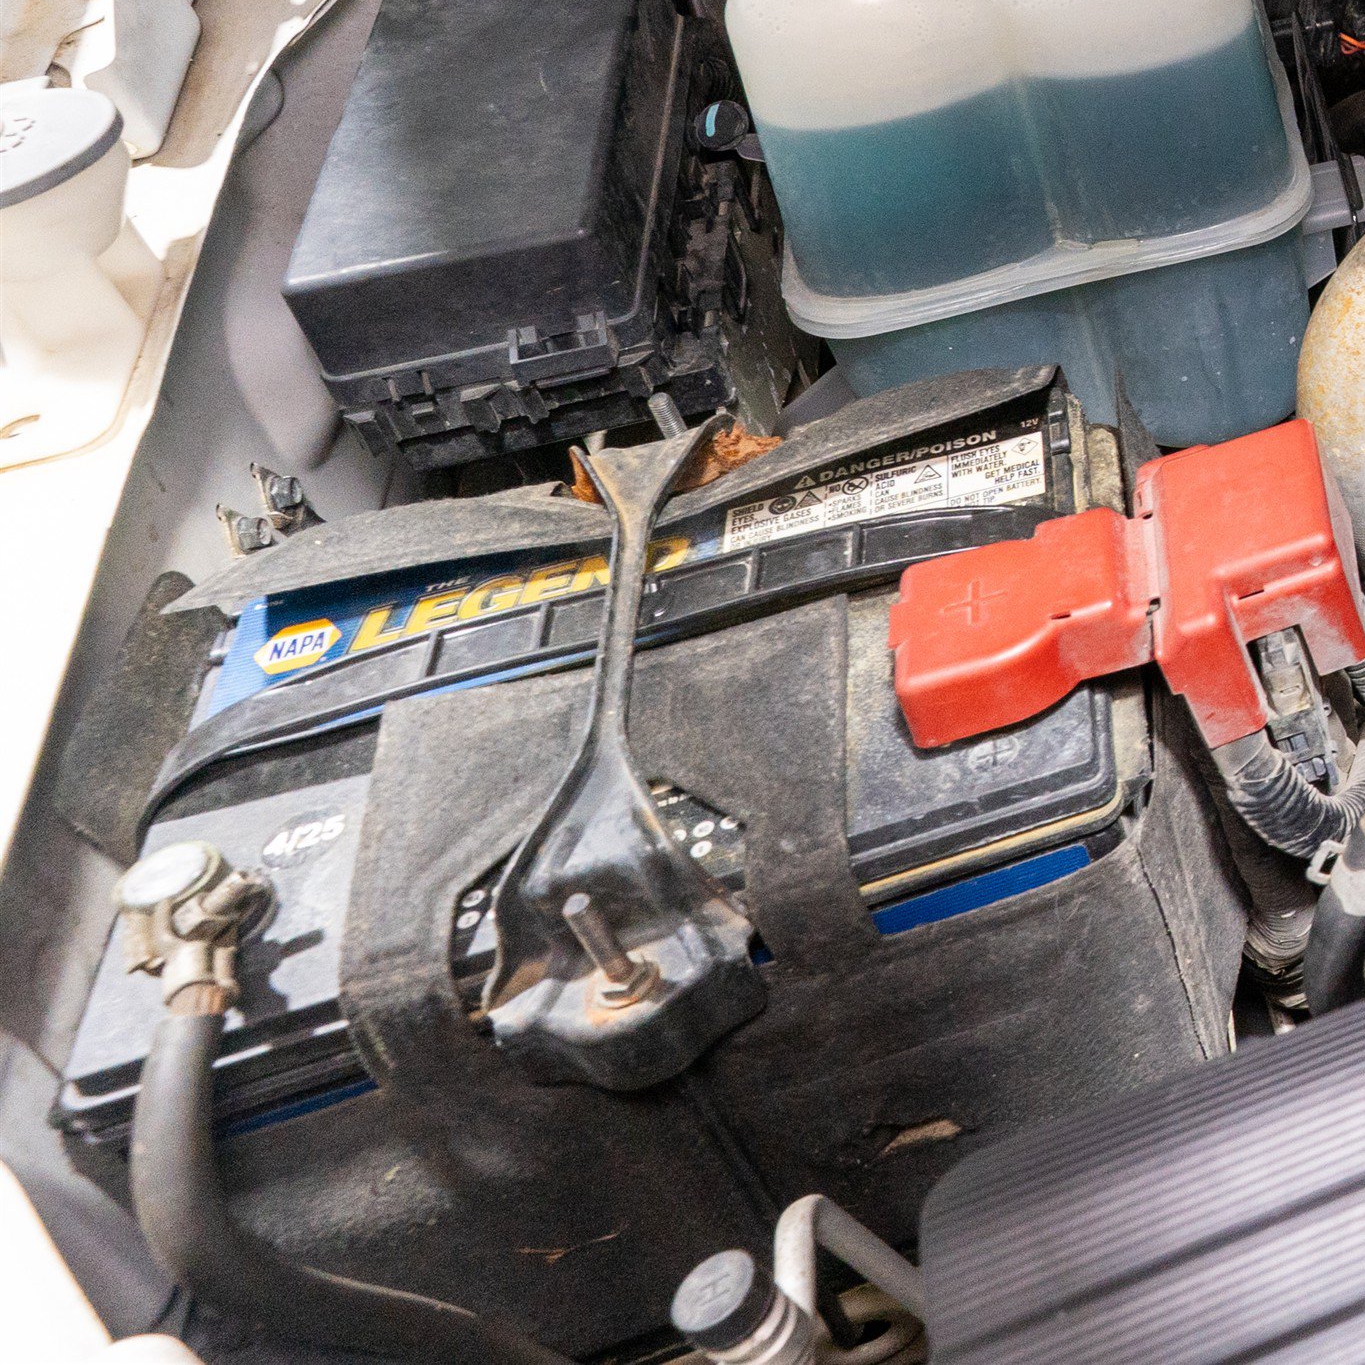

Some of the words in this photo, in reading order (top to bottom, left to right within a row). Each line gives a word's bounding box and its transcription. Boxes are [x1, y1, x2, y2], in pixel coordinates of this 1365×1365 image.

[1020, 418, 1039, 429] 12V
[819, 430, 997, 482] DANGER/POISON
[951, 452, 977, 463] FLUSH
[979, 445, 1000, 455] EYES
[951, 451, 1008, 471] IMMEDIATELY
[875, 465, 917, 482] SULFURIC
[951, 467, 973, 479] WITH
[985, 470, 1000, 480] GET
[1003, 459, 1040, 474] MEDICAL
[875, 480, 896, 491] ACID
[994, 474, 1015, 485] HELP
[828, 484, 841, 494] NO
[875, 489, 890, 498] CAN
[950, 497, 962, 507] DO
[964, 492, 980, 503] NOT
[982, 487, 1004, 498] OPEN
[874, 494, 899, 506] CAUSE
[887, 497, 916, 510] SEVERE
[917, 491, 944, 503] BURNS
[733, 503, 764, 517] SHIELD
[731, 516, 780, 535] EXPLOSIVE
[783, 508, 812, 522] GASES
[748, 526, 775, 540] CAUSE
[776, 515, 820, 532] BLINDNESS
[426, 575, 471, 592] THE
[268, 631, 325, 661] NAPA
[262, 814, 346, 856] 4/25
